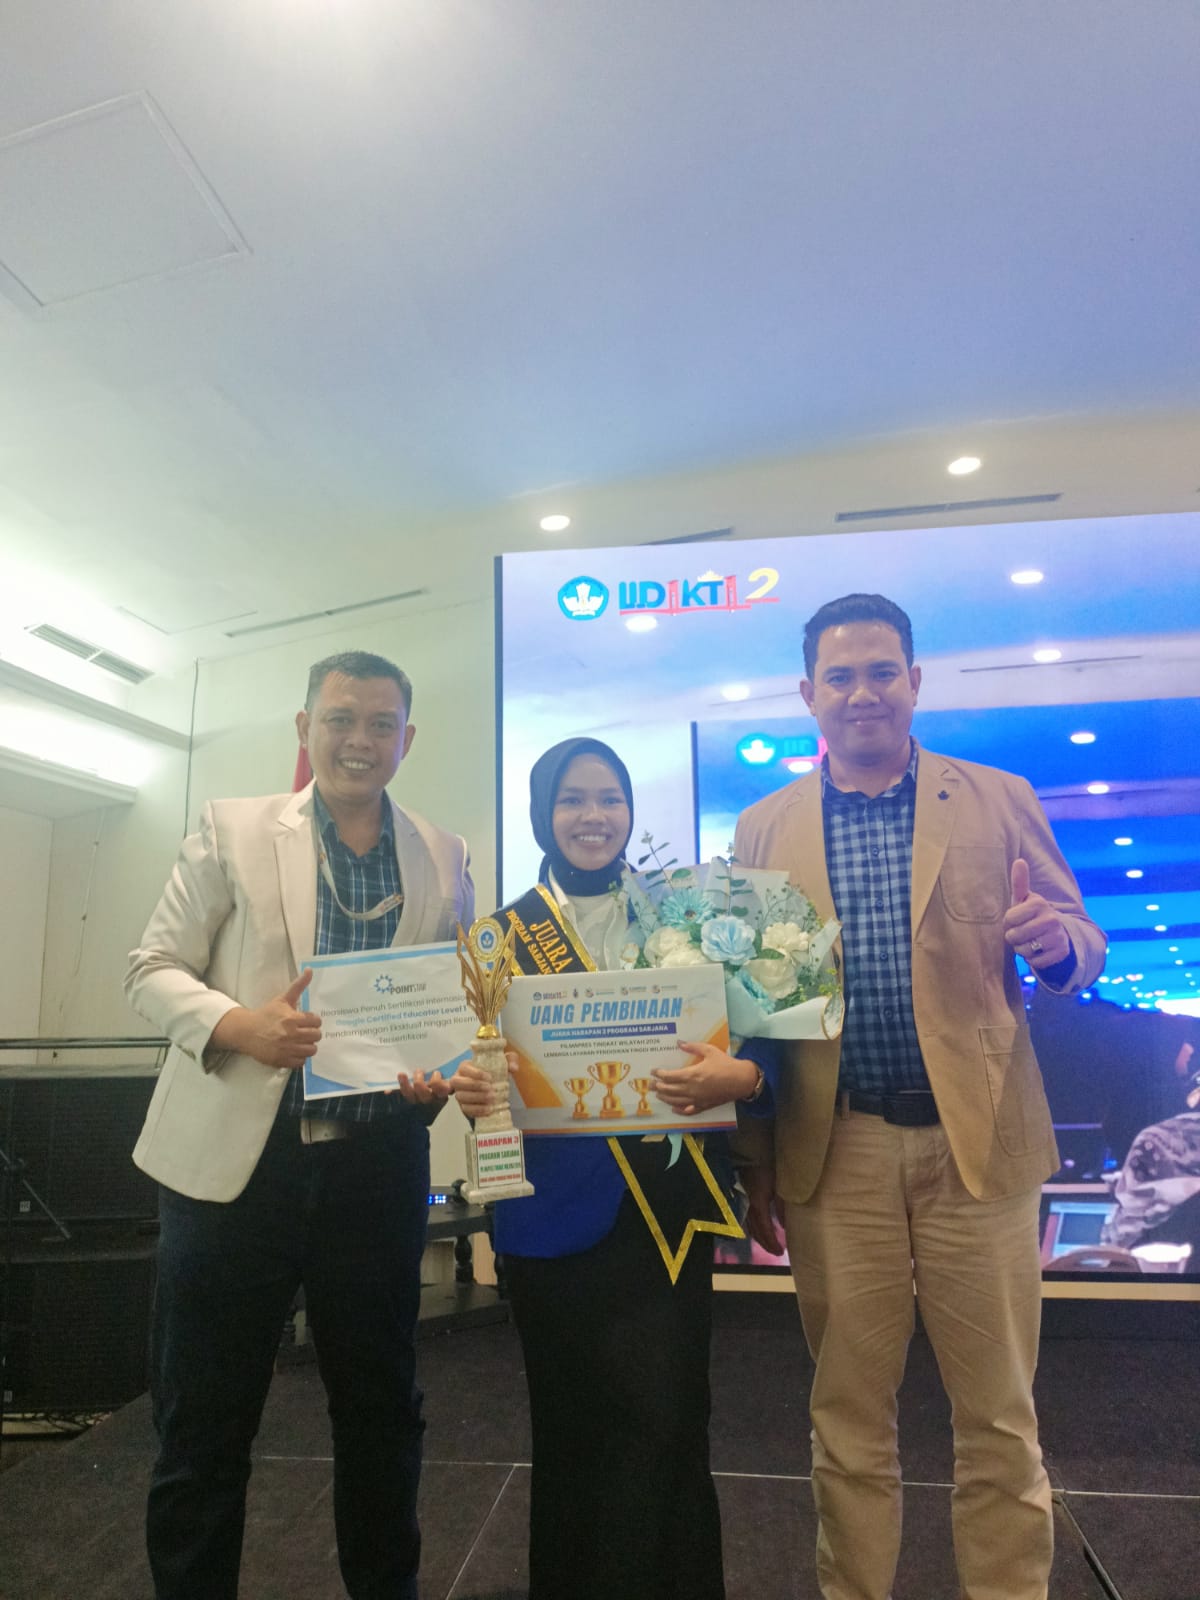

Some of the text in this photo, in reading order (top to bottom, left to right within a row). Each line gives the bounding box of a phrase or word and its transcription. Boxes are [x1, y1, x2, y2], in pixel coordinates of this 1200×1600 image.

[745, 567, 780, 601] 2
[505, 909, 553, 975] PROGRAM SARJAN
[529, 919, 573, 973] JUARA
[360, 1004, 386, 1013] Penuh
[387, 998, 424, 1009] Sertifikasi
[425, 993, 468, 1005] Internasio
[529, 997, 683, 1026] UANG PEMBINAAN
[366, 1013, 401, 1023] Certified
[403, 1009, 439, 1019] Educator
[441, 1006, 462, 1015] Level
[325, 1026, 389, 1039] Pendampingan
[423, 1017, 452, 1029] hingga
[607, 1026, 638, 1035] PROGRAM
[638, 1024, 669, 1033] SARJANA
[478, 1137, 512, 1148] HARAPAN
